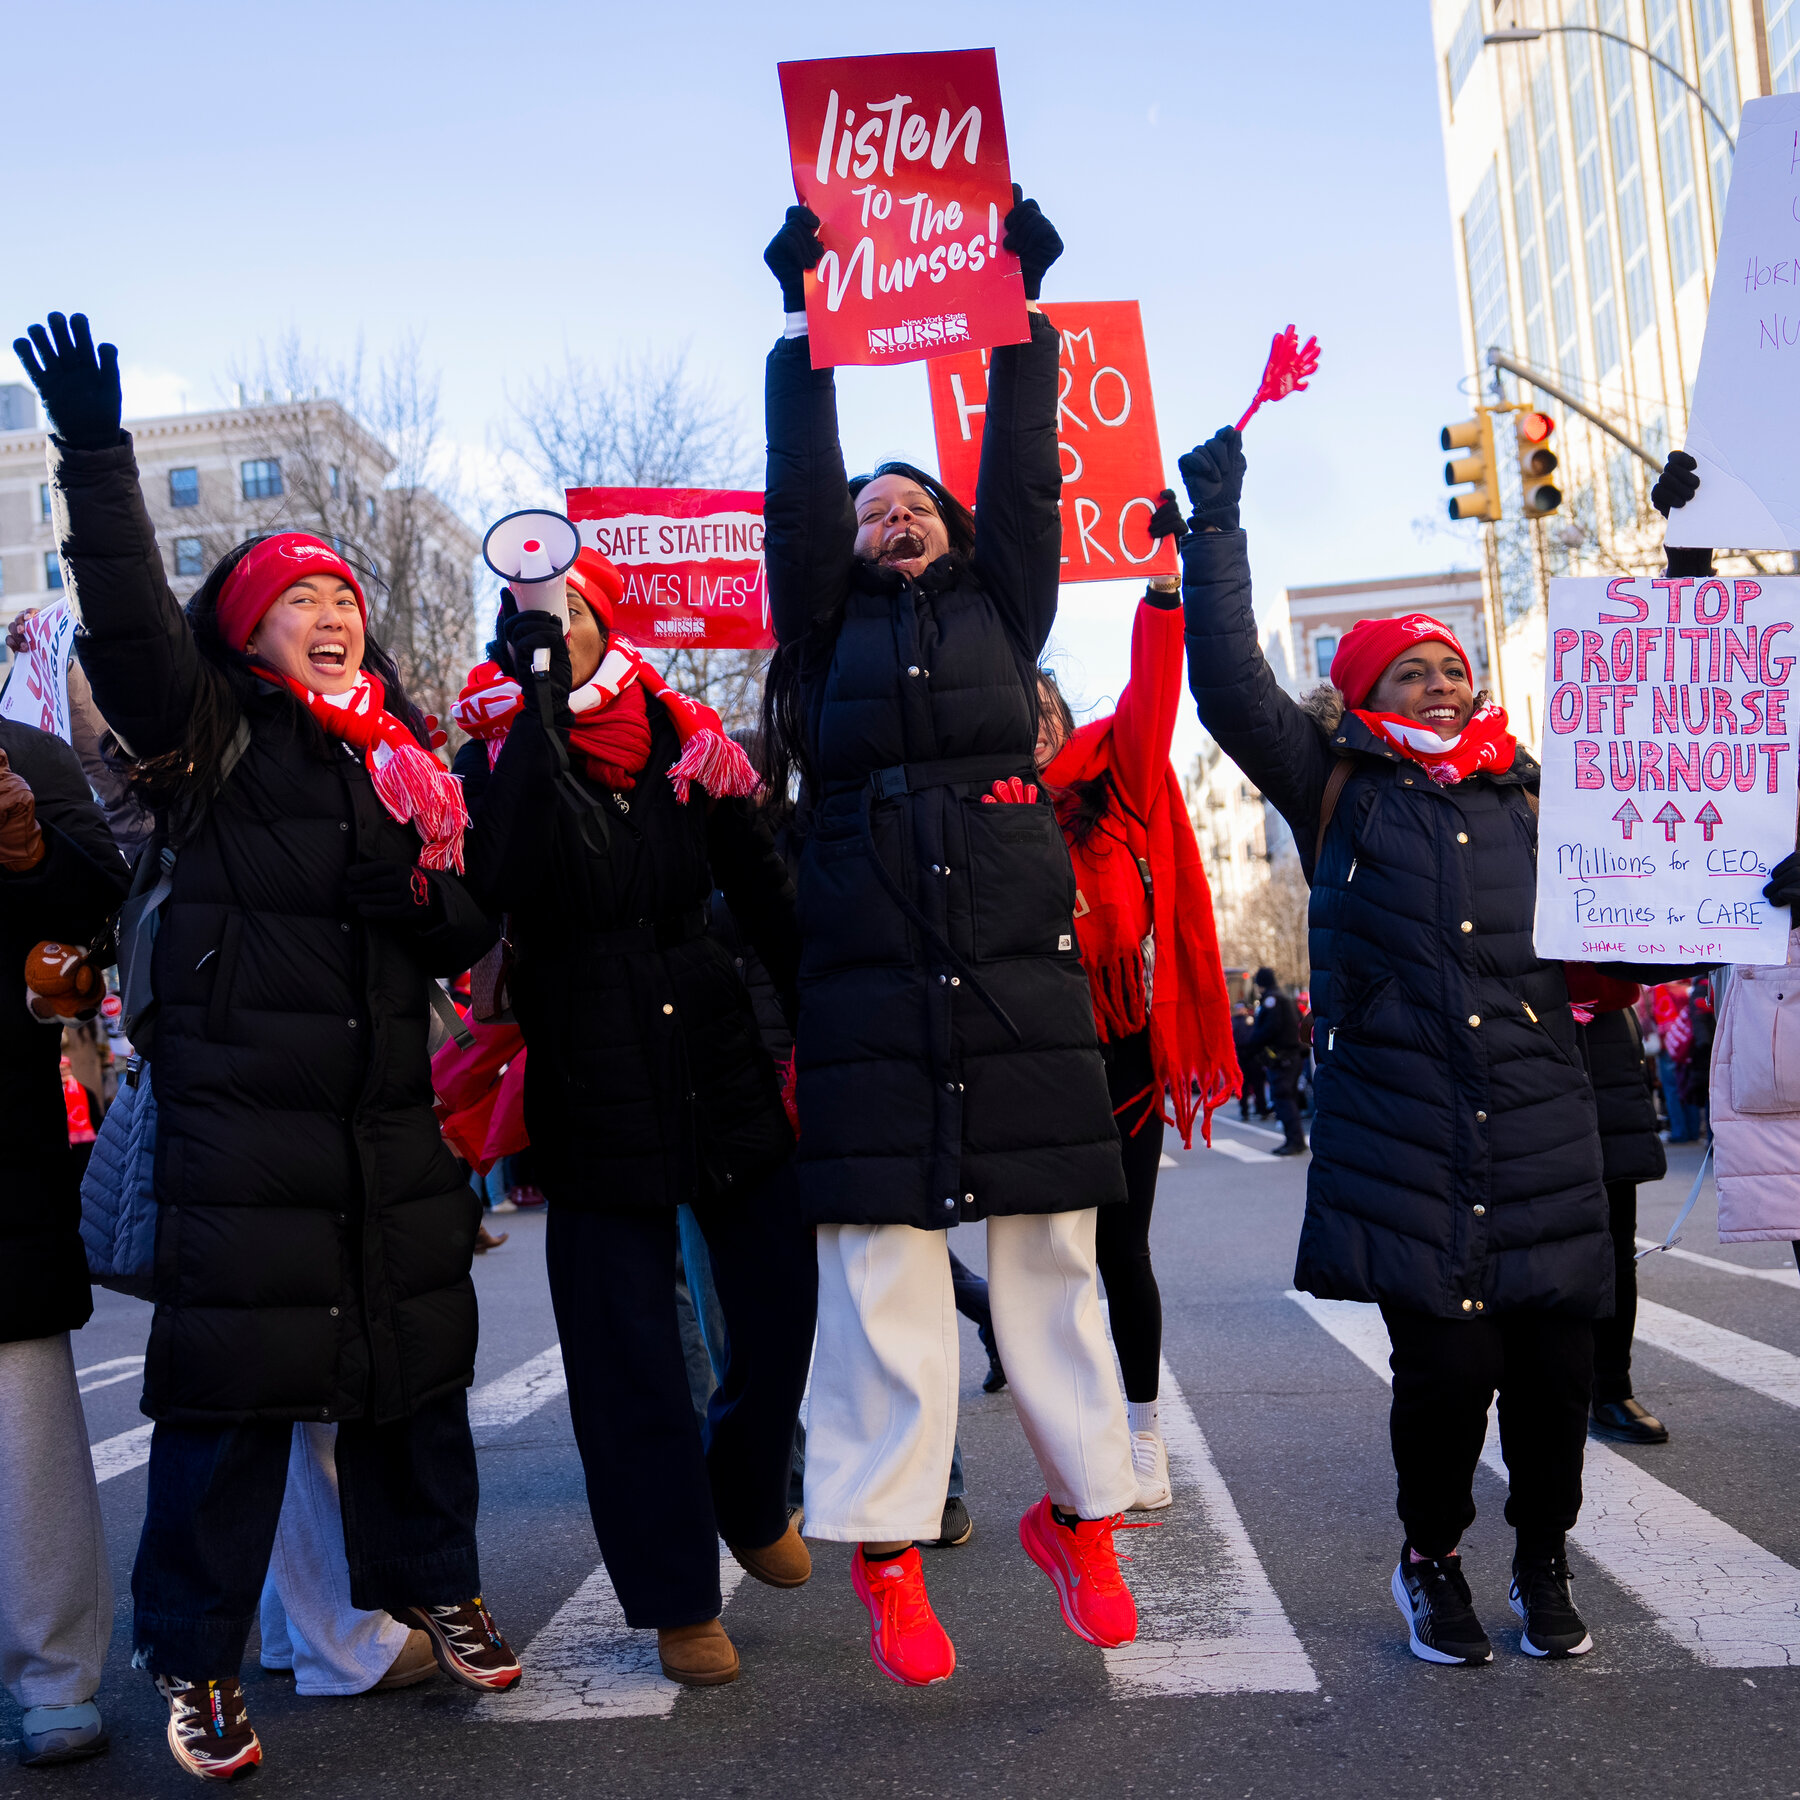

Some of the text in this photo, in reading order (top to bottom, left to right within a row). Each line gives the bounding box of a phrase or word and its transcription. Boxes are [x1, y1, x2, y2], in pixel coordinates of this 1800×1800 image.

[817, 202, 998, 312] Nurses!
[867, 317, 968, 347] NURSES
[902, 312, 966, 327] New York State
[869, 331, 971, 354] ASSOCIATION
[950, 366, 1132, 441] HRO
[596, 523, 765, 557] SAFE STAFFING
[688, 575, 747, 607] LIVES
[1598, 577, 1762, 625] STOP
[653, 620, 705, 633] NURSES
[1553, 621, 1797, 687] PROFITING
[1550, 682, 1790, 736] OFF NURSE
[1574, 740, 1790, 794] BURNOUT
[1557, 843, 1656, 883] Millions
[1669, 849, 1690, 871] for
[1573, 888, 1766, 925] Pennies for CARE
[1581, 941, 1722, 958] SHAME ON NYP!
